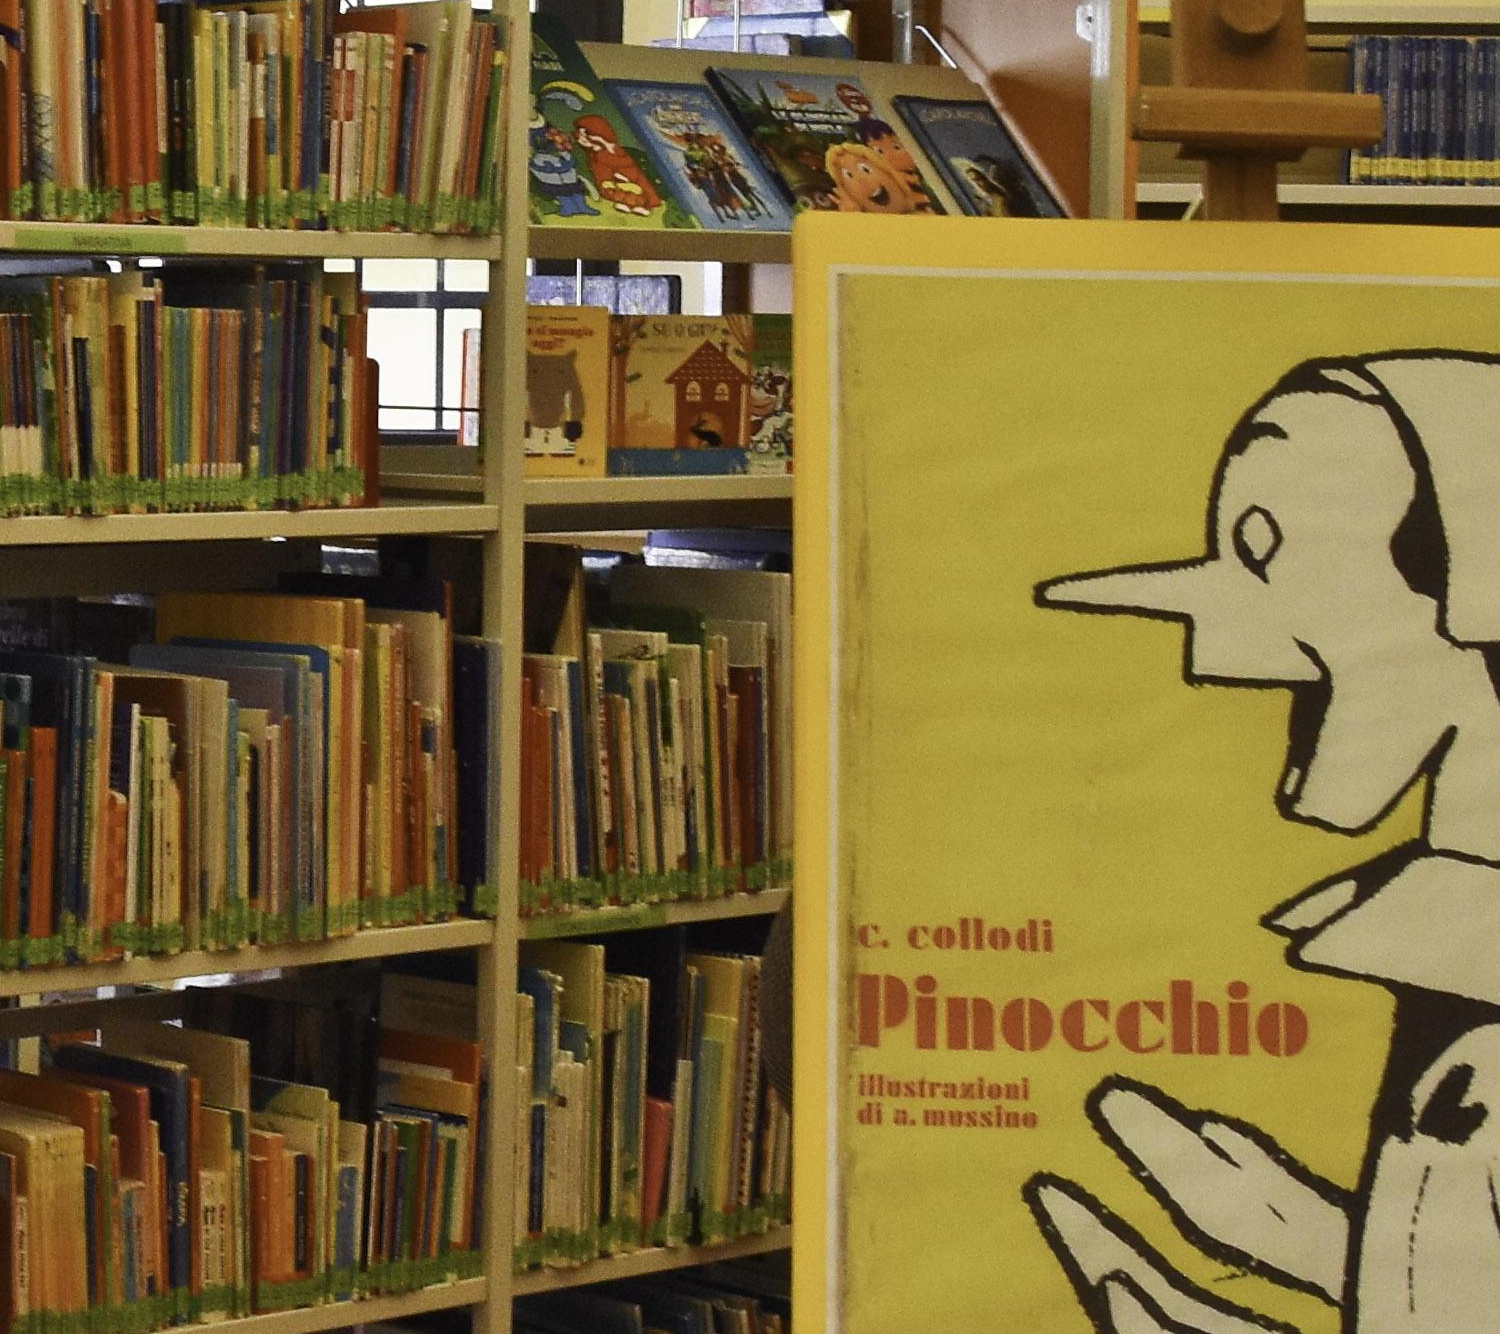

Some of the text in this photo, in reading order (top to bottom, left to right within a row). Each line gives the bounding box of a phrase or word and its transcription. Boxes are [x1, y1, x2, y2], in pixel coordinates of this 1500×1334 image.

[857, 917, 1054, 953] c. collodi
[857, 973, 1309, 1058] Pinocchio
[858, 1074, 1029, 1101] illustrazioni
[857, 1103, 1039, 1129] di a. mussino
